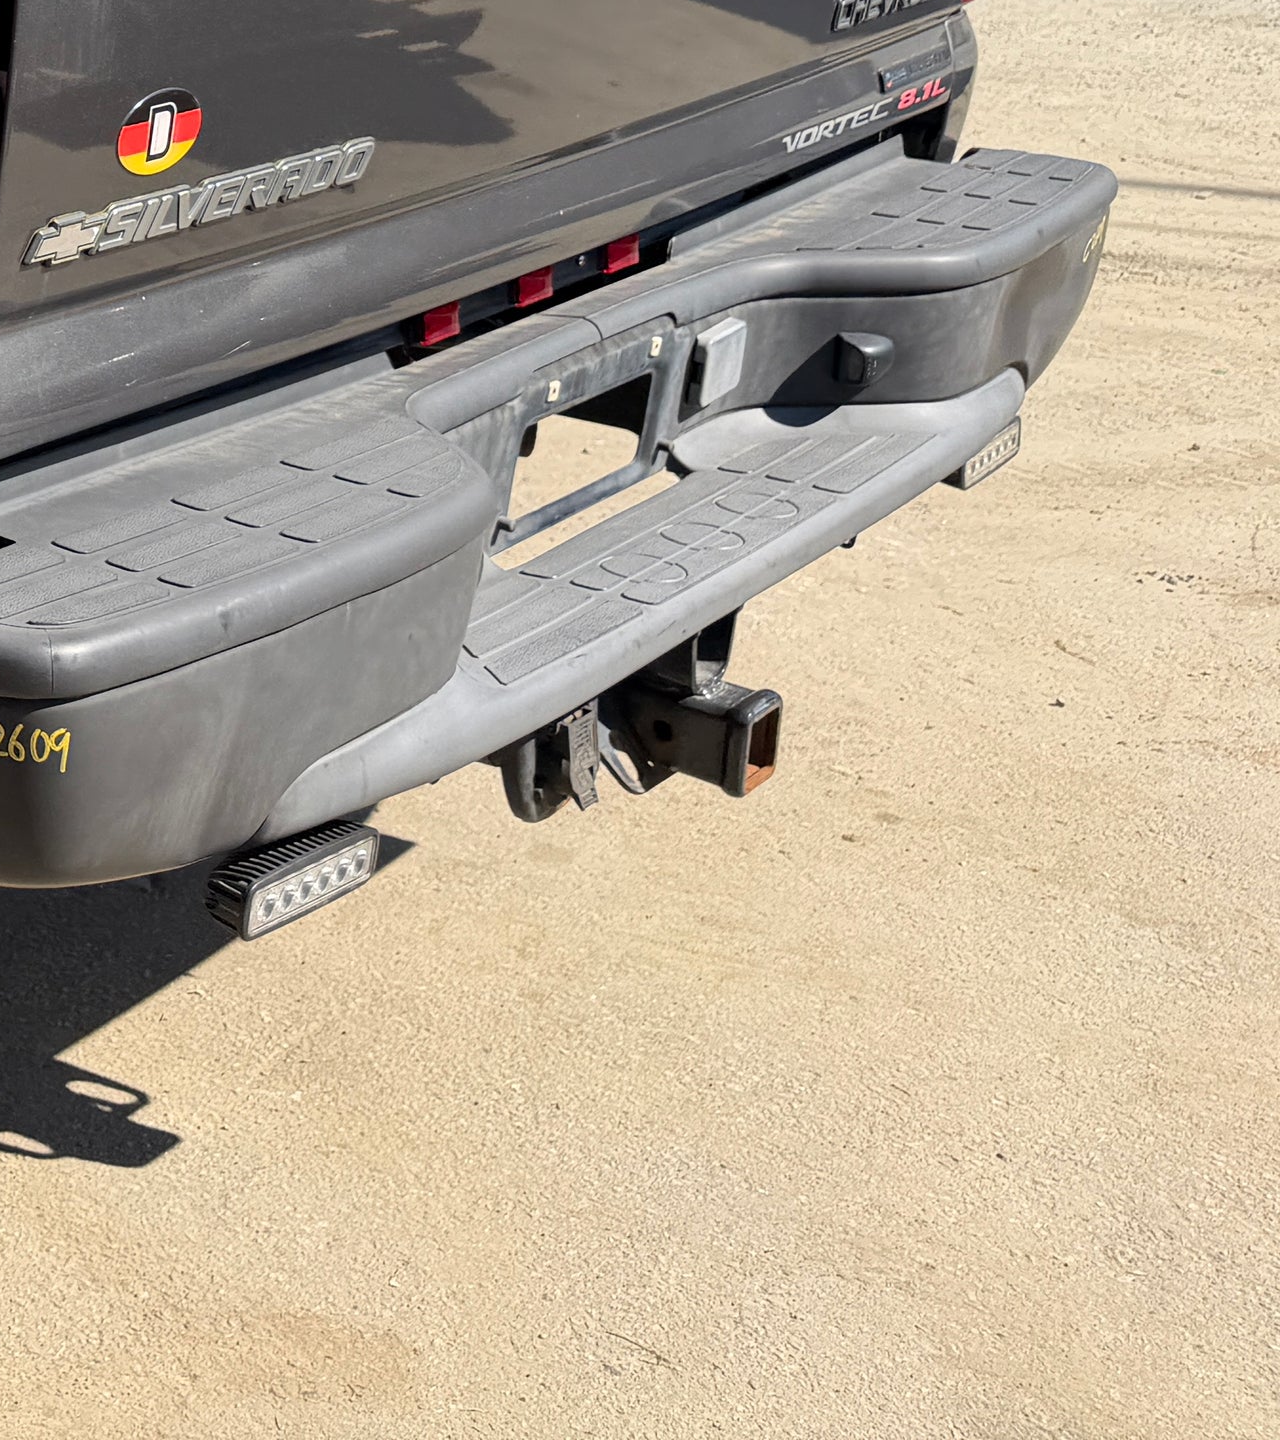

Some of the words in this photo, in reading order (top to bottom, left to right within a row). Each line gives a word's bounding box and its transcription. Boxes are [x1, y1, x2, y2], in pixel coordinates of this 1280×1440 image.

[146, 101, 178, 161] D
[782, 97, 893, 153] VORTEC
[897, 77, 947, 111] 8.1L
[95, 136, 376, 254] SILVERADO
